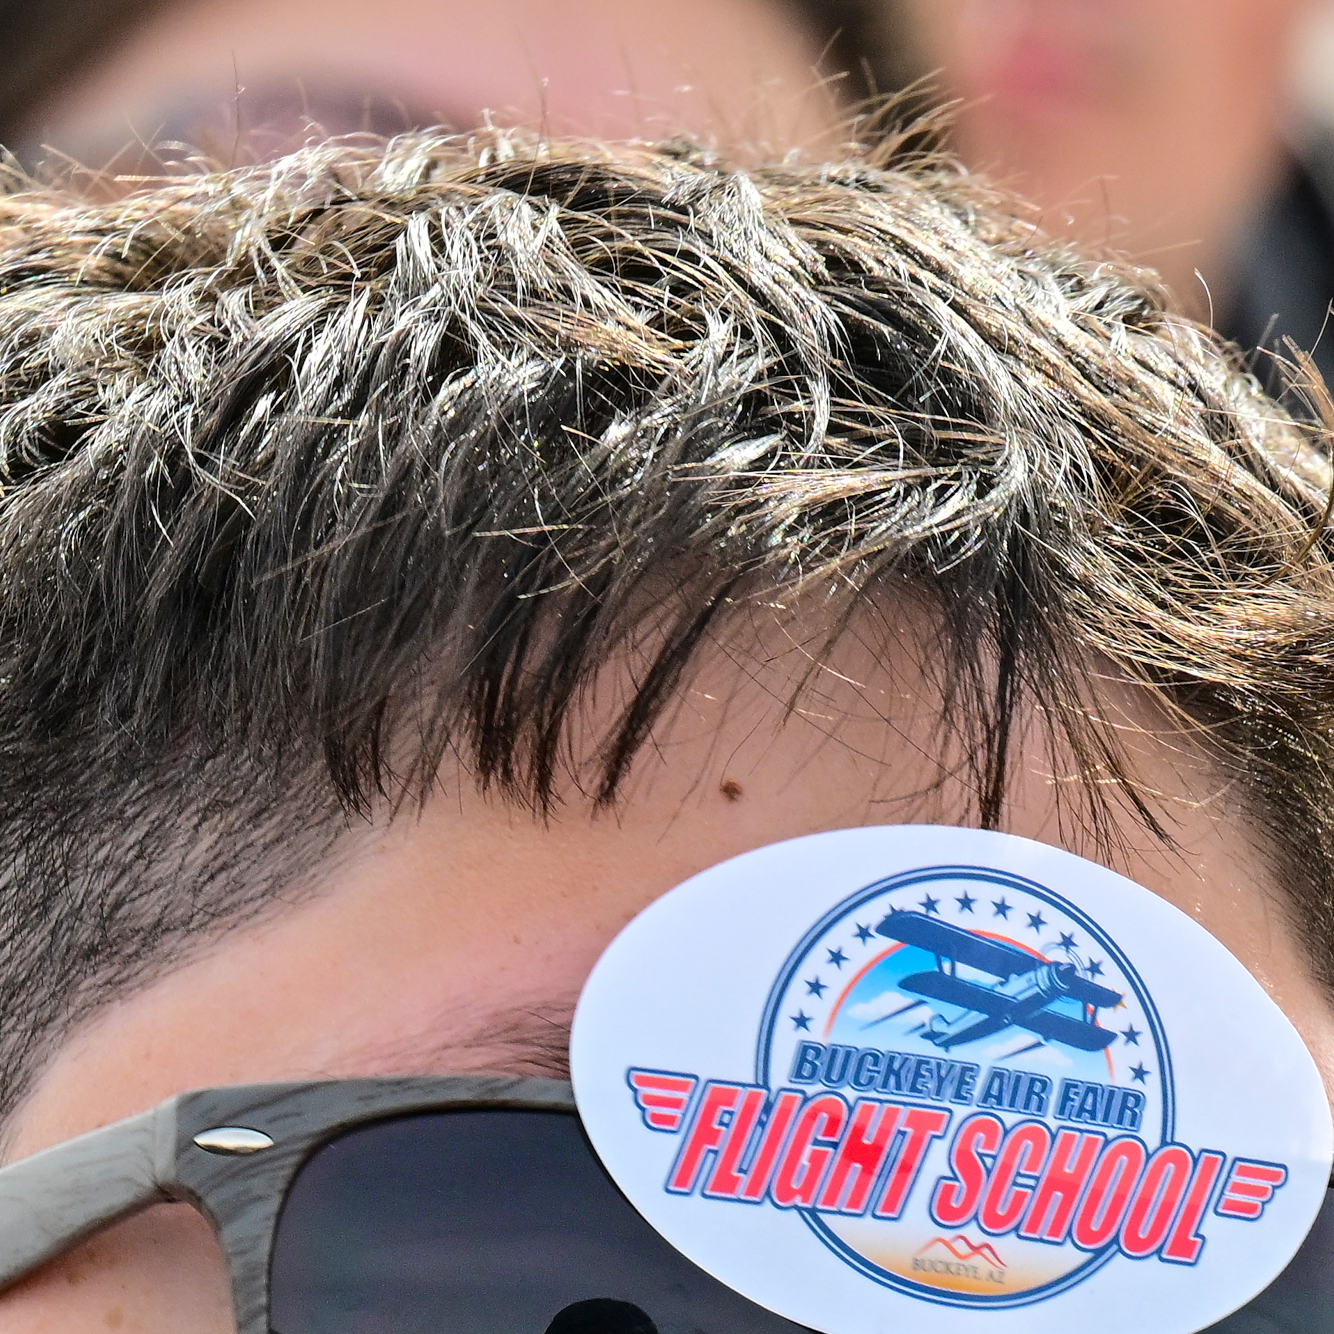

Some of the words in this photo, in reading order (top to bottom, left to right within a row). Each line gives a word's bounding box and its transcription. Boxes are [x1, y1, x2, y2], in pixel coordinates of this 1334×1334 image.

[789, 1039, 980, 1105] BUCKEYE
[977, 1067, 1053, 1117] AIR
[1054, 1078, 1147, 1132] FAIR
[664, 1079, 951, 1221] FLIGHT
[929, 1112, 1228, 1266] SCHOOL
[985, 1269, 1006, 1285] AZ
